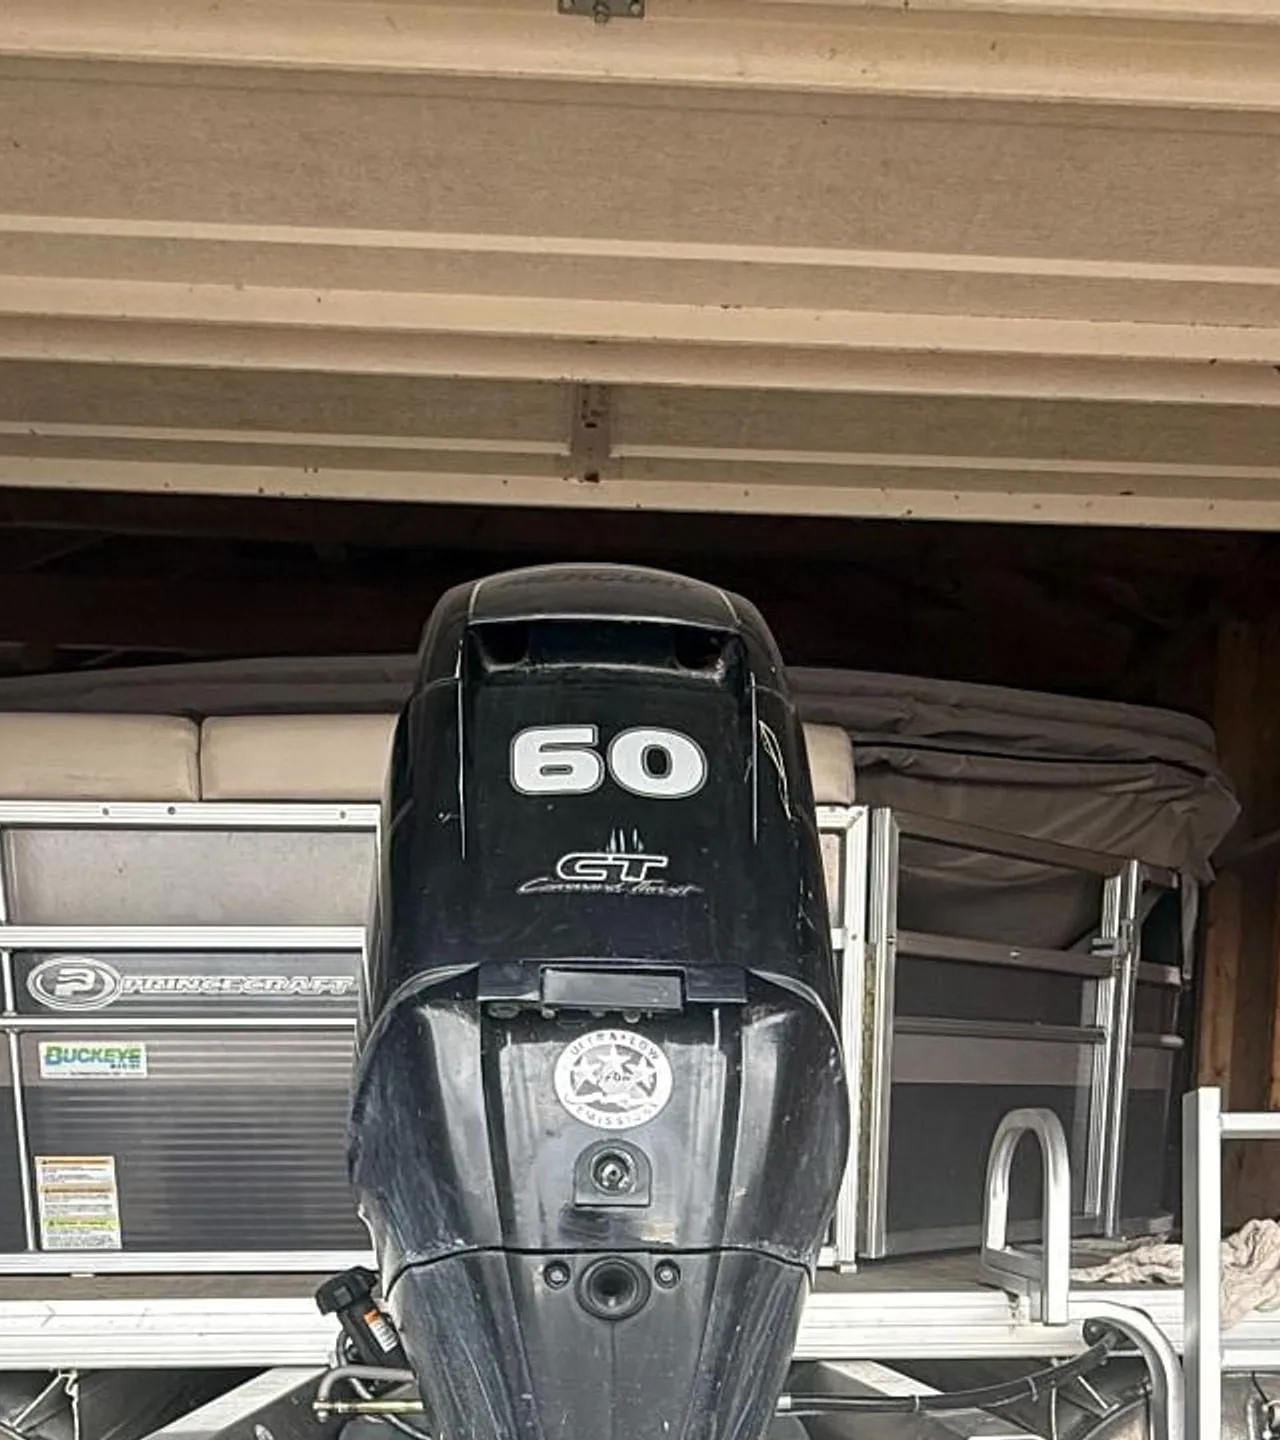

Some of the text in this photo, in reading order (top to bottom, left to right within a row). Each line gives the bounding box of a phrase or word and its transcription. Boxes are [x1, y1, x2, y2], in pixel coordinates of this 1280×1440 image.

[509, 724, 708, 799] 60
[120, 976, 355, 994] PRINCECRAFT
[44, 1046, 142, 1066] BUCKEYE
[570, 1032, 660, 1060] ULTRA LOW
